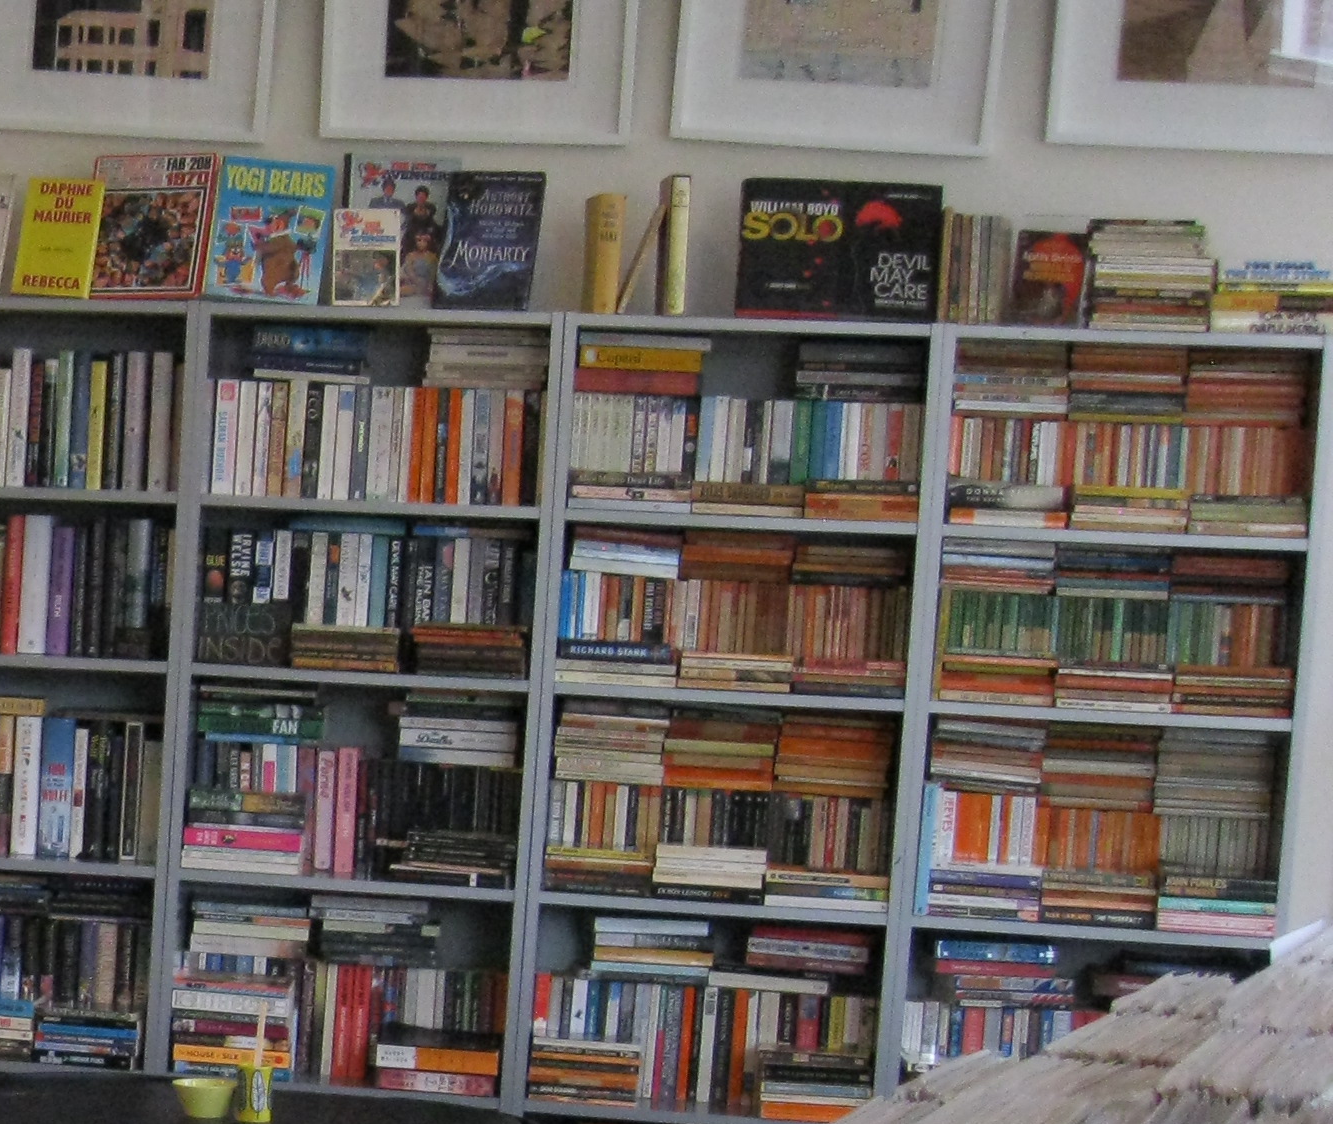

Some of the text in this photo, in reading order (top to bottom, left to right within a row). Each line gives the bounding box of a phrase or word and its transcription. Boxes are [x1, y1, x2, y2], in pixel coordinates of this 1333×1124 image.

[226, 164, 266, 192] YOGI
[40, 182, 95, 196] DAPHNE
[55, 196, 74, 209] DU
[470, 200, 536, 217] HOROWITZ
[807, 201, 840, 216] BOYD
[32, 210, 93, 224] MAURIER
[742, 210, 845, 242] SOLO
[450, 240, 531, 270] MORIARTY
[877, 252, 931, 271] DEVIL
[21, 273, 81, 290] REBECCA
[870, 267, 915, 284] MAY
[874, 282, 928, 300] CARE
[206, 553, 226, 567] GLUE
[232, 533, 243, 577] WELSH
[241, 533, 254, 578] IRVINE
[422, 565, 434, 596] IAIN
[570, 644, 648, 658] RICHARD STARK
